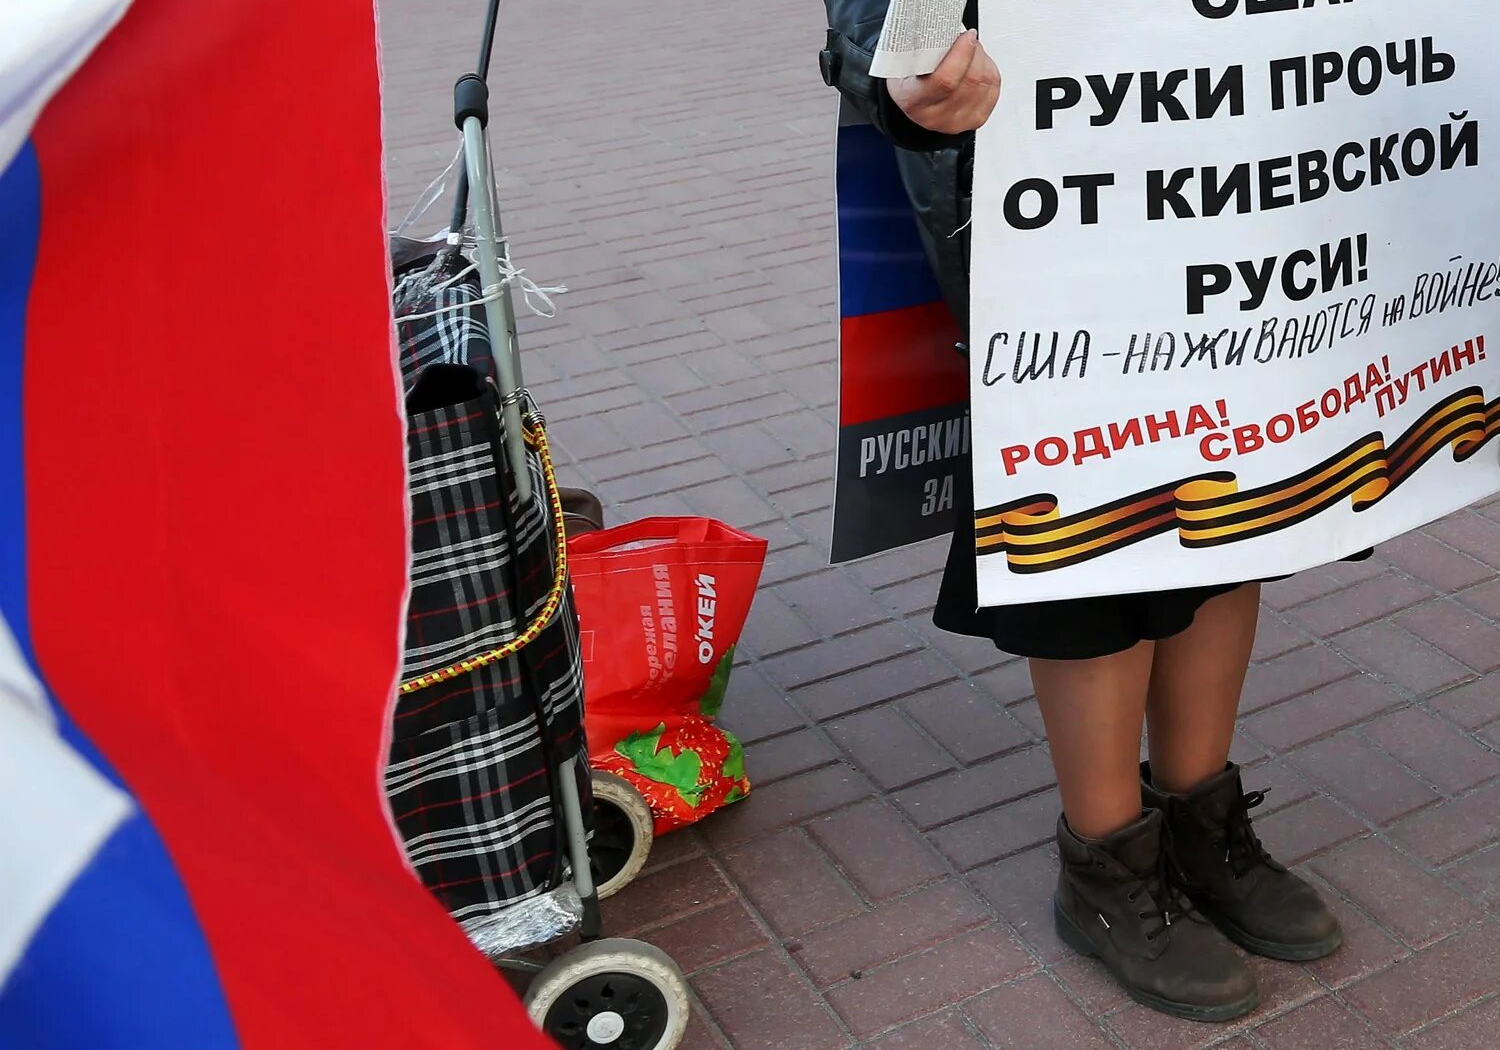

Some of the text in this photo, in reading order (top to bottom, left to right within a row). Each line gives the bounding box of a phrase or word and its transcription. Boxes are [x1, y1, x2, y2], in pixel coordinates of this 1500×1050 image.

[1035, 36, 1456, 131] РУКИ ПРОЧЬ
[1002, 110, 1480, 231] ОТ КИЕВСКОЙ
[1186, 232, 1369, 315] РУСИ!
[1199, 356, 1391, 462] СВОБОДА!
[1375, 335, 1487, 418] ПУТИН!
[1001, 399, 1231, 476] РОДИНА!
